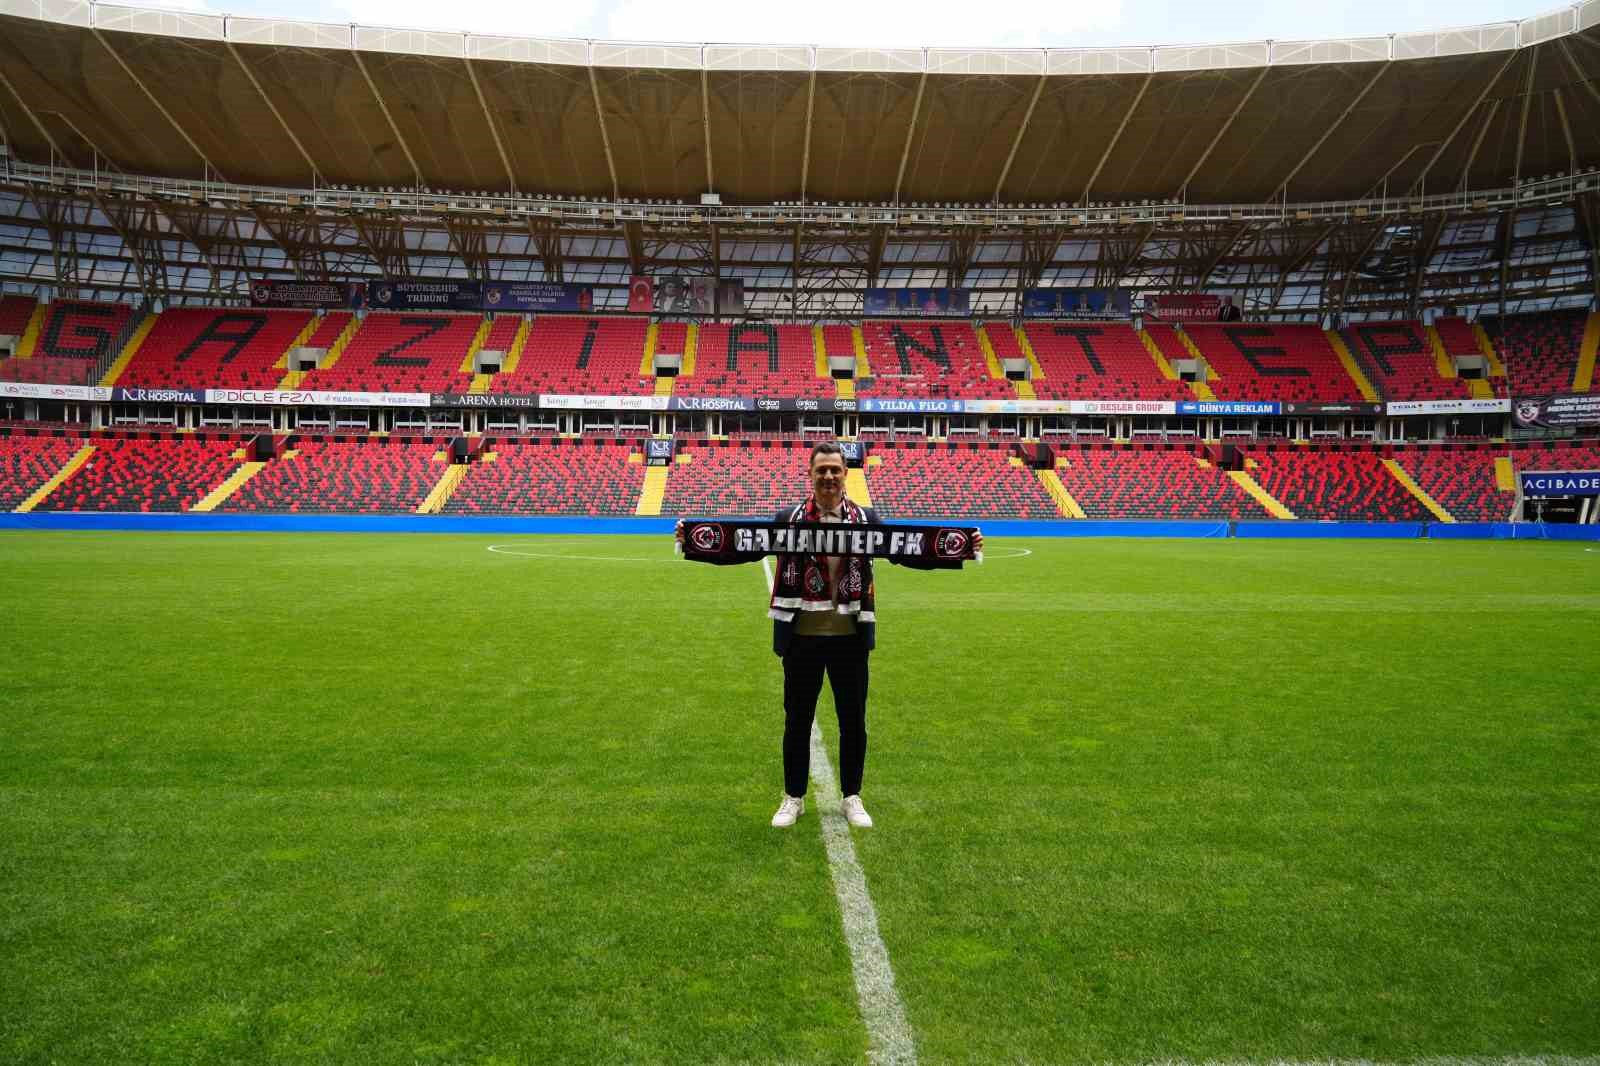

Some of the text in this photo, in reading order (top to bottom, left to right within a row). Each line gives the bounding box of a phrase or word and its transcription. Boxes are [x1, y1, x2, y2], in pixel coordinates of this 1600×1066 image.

[148, 391, 197, 402] HOSPITAL
[458, 395, 530, 406] ARENA HOTEL
[701, 398, 746, 410] HOSPITAL
[1233, 404, 1273, 413] REKLAM
[890, 531, 924, 555] FK
